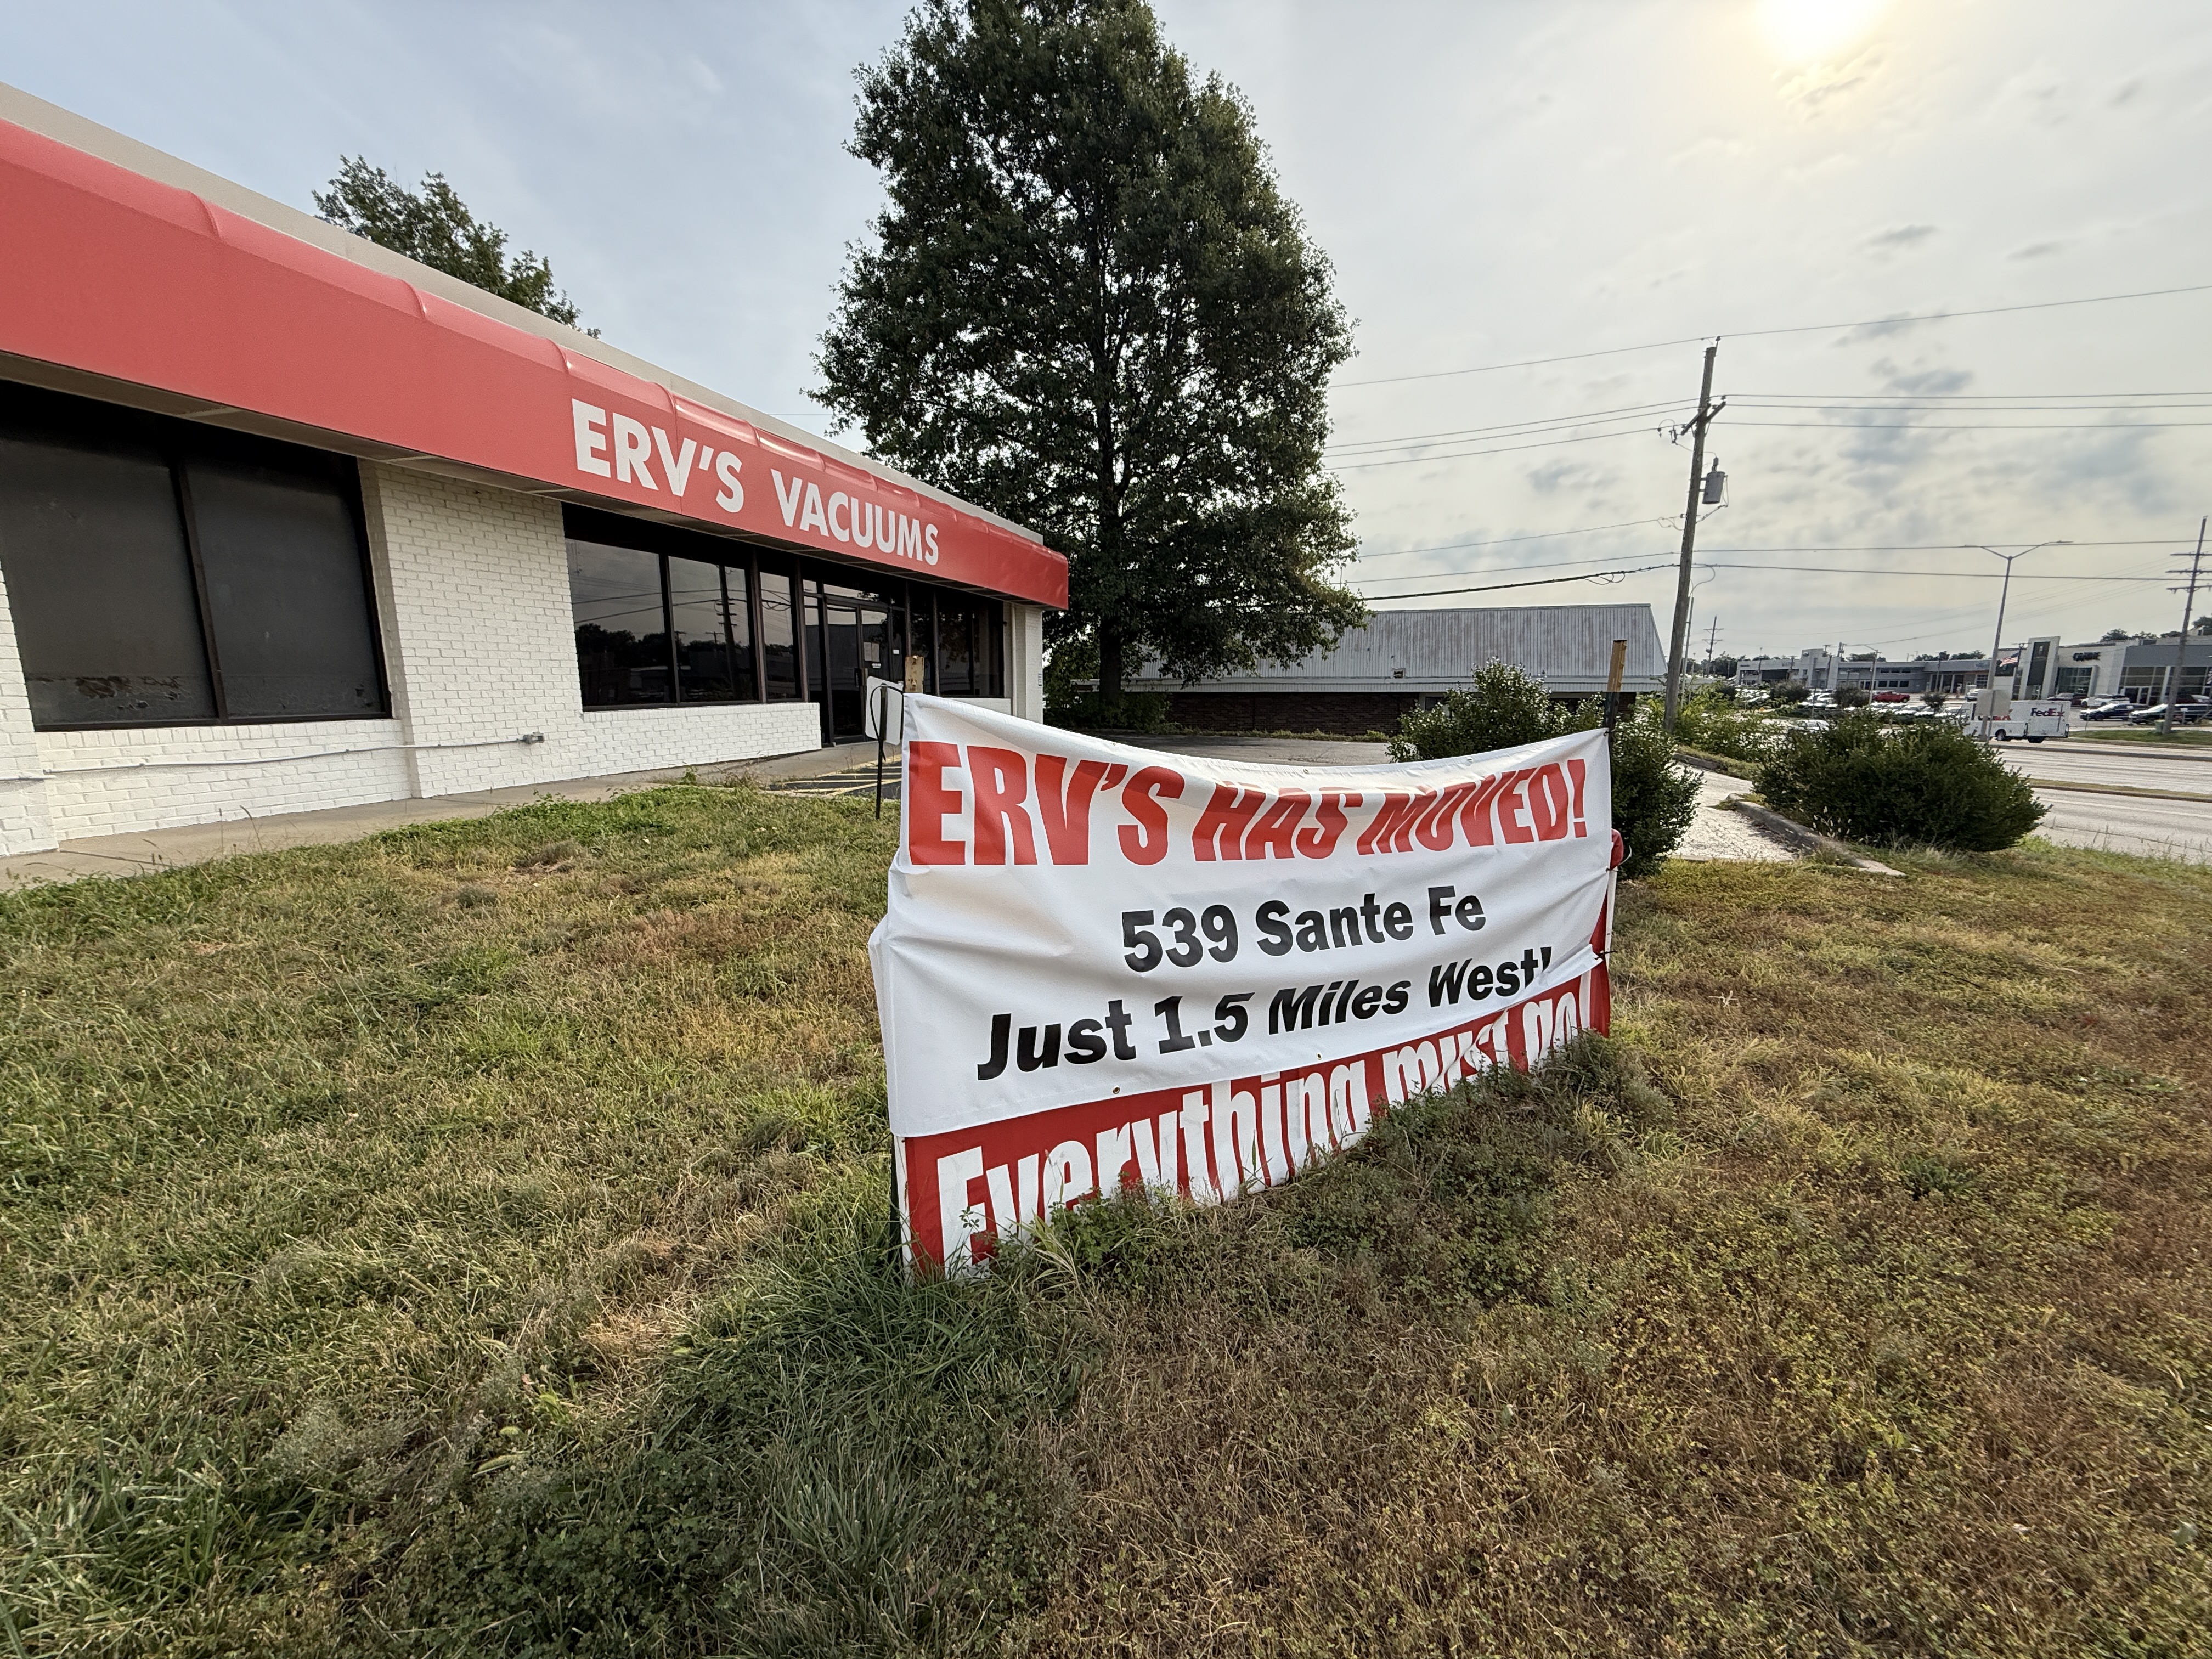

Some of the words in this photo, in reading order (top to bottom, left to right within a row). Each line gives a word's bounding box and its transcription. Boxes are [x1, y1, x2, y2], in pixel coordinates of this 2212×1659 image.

[572, 398, 745, 513] ERV'S
[771, 469, 939, 566] VACUUMS
[2031, 707, 2065, 717] FedEx
[909, 741, 1185, 866] ERV'S
[1192, 781, 1364, 861] HAS
[1357, 759, 1587, 856] MOVED!
[1122, 904, 1239, 973] 539
[1256, 893, 1414, 956] Sante
[1427, 885, 1486, 935] Fe
[977, 1000, 1137, 1081] Just
[1154, 992, 1256, 1054] 1.5
[1268, 979, 1411, 1035] Miles
[937, 1060, 1373, 1280] Everything
